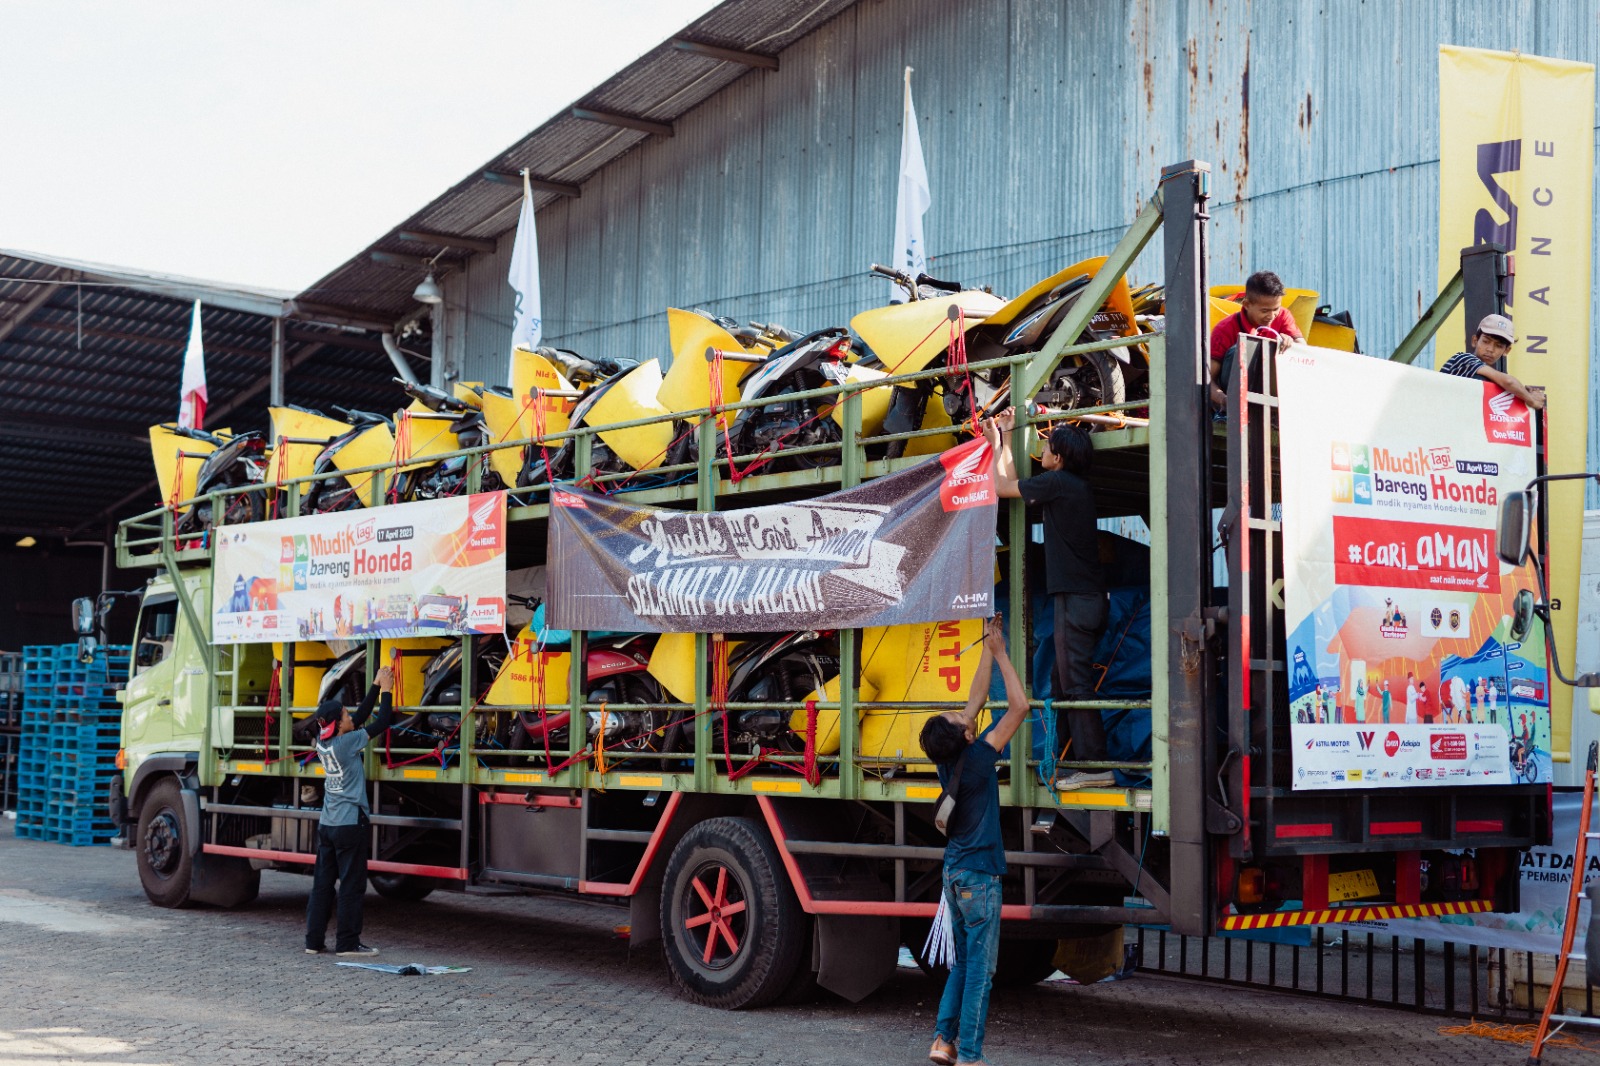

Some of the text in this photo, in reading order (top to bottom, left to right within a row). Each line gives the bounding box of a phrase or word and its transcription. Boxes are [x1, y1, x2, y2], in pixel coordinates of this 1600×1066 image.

[1493, 429, 1507, 439] One
[1373, 447, 1498, 476] Mudik lagi 17 April 2023
[948, 473, 990, 487] HONDA
[1374, 473, 1498, 506] bareng Honda
[952, 495, 968, 506] One
[1376, 499, 1401, 508] mudik
[1403, 501, 1432, 511] nyaman
[1469, 507, 1487, 516] aman
[310, 521, 413, 557] Mudik lagi 17 April 2023
[628, 510, 727, 567] Mudik
[310, 544, 413, 579] bareng Honda
[952, 593, 988, 604] AHM
[471, 609, 495, 617] AHM
[939, 620, 960, 693] MTP
[1550, 853, 1600, 871] DAA
